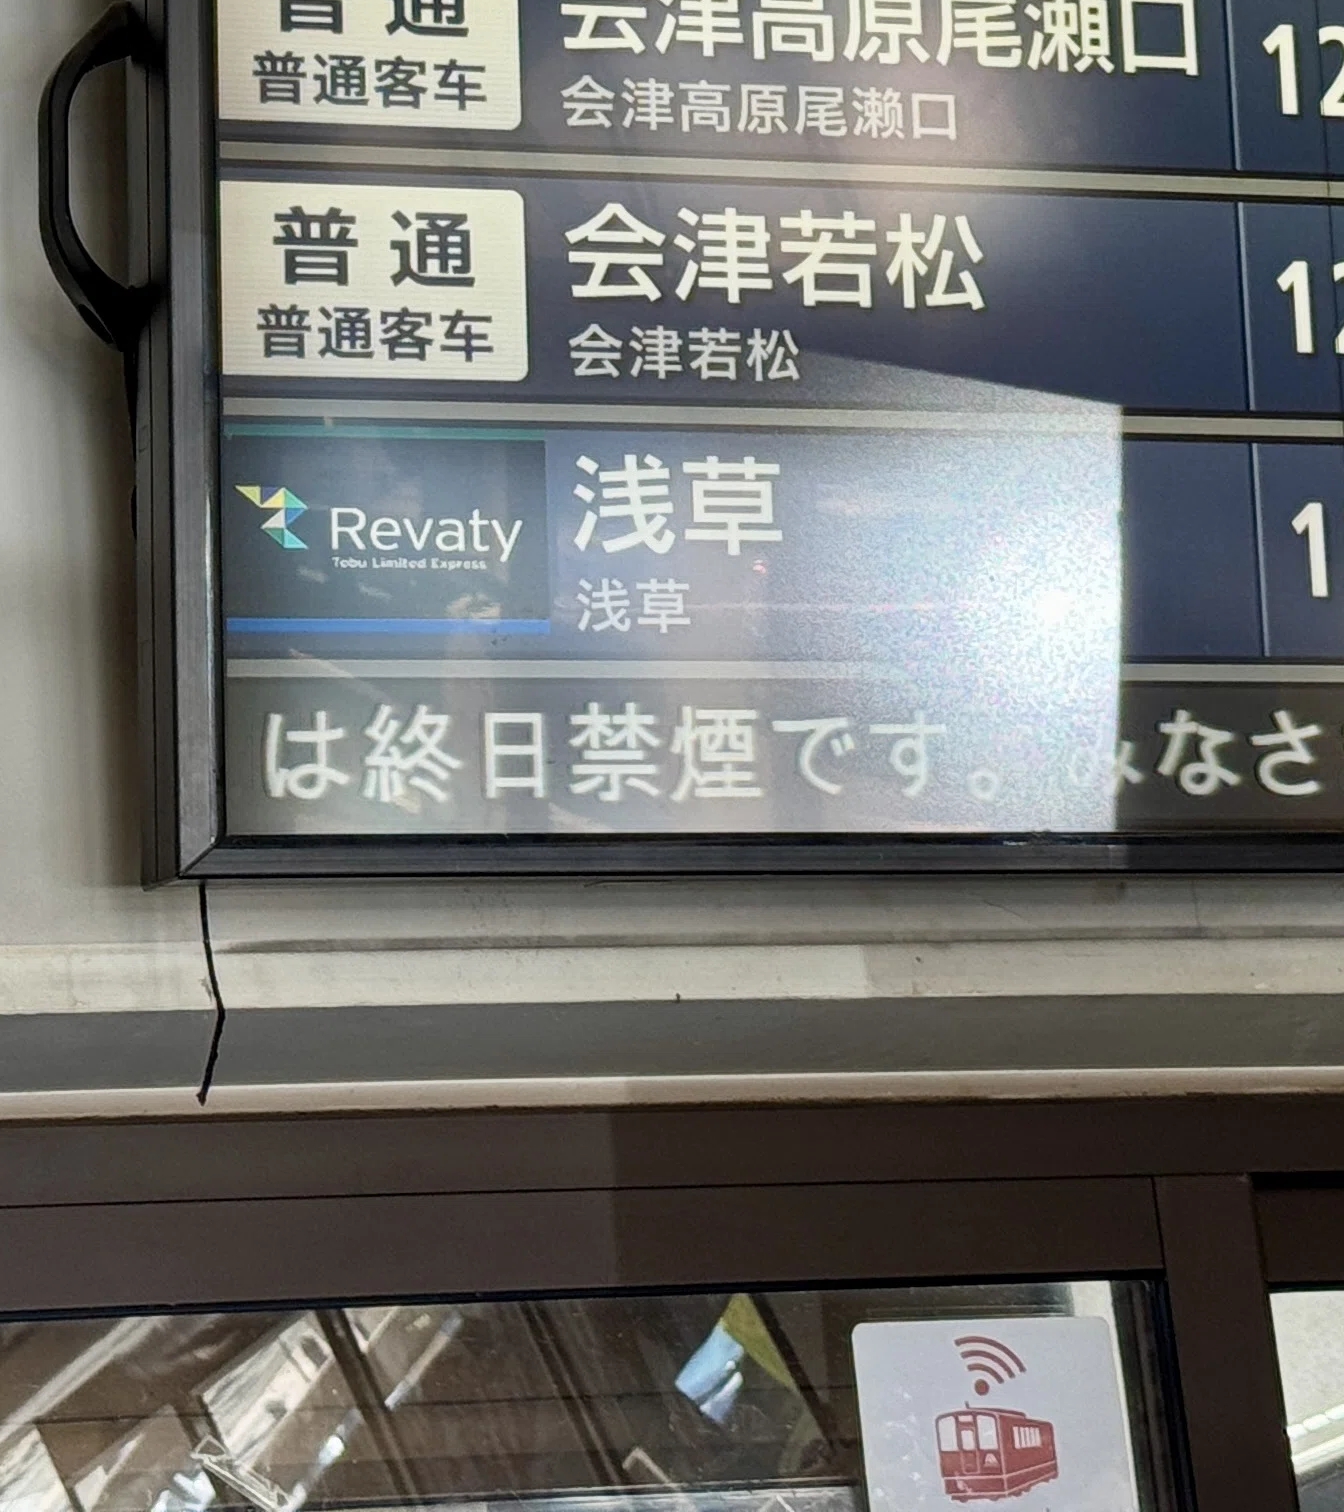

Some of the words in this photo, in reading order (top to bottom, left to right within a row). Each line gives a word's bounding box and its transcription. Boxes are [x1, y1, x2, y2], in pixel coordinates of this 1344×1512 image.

[252, 48, 488, 112] 普通客车
[564, 202, 986, 311] 会津若松
[256, 304, 495, 364] 普通客车
[568, 322, 801, 383] 会津若松
[330, 507, 523, 562] Revaty
[572, 454, 785, 558] 浅草
[372, 557, 426, 569] Limited
[431, 558, 487, 571] Express
[576, 578, 692, 634] 浅草
